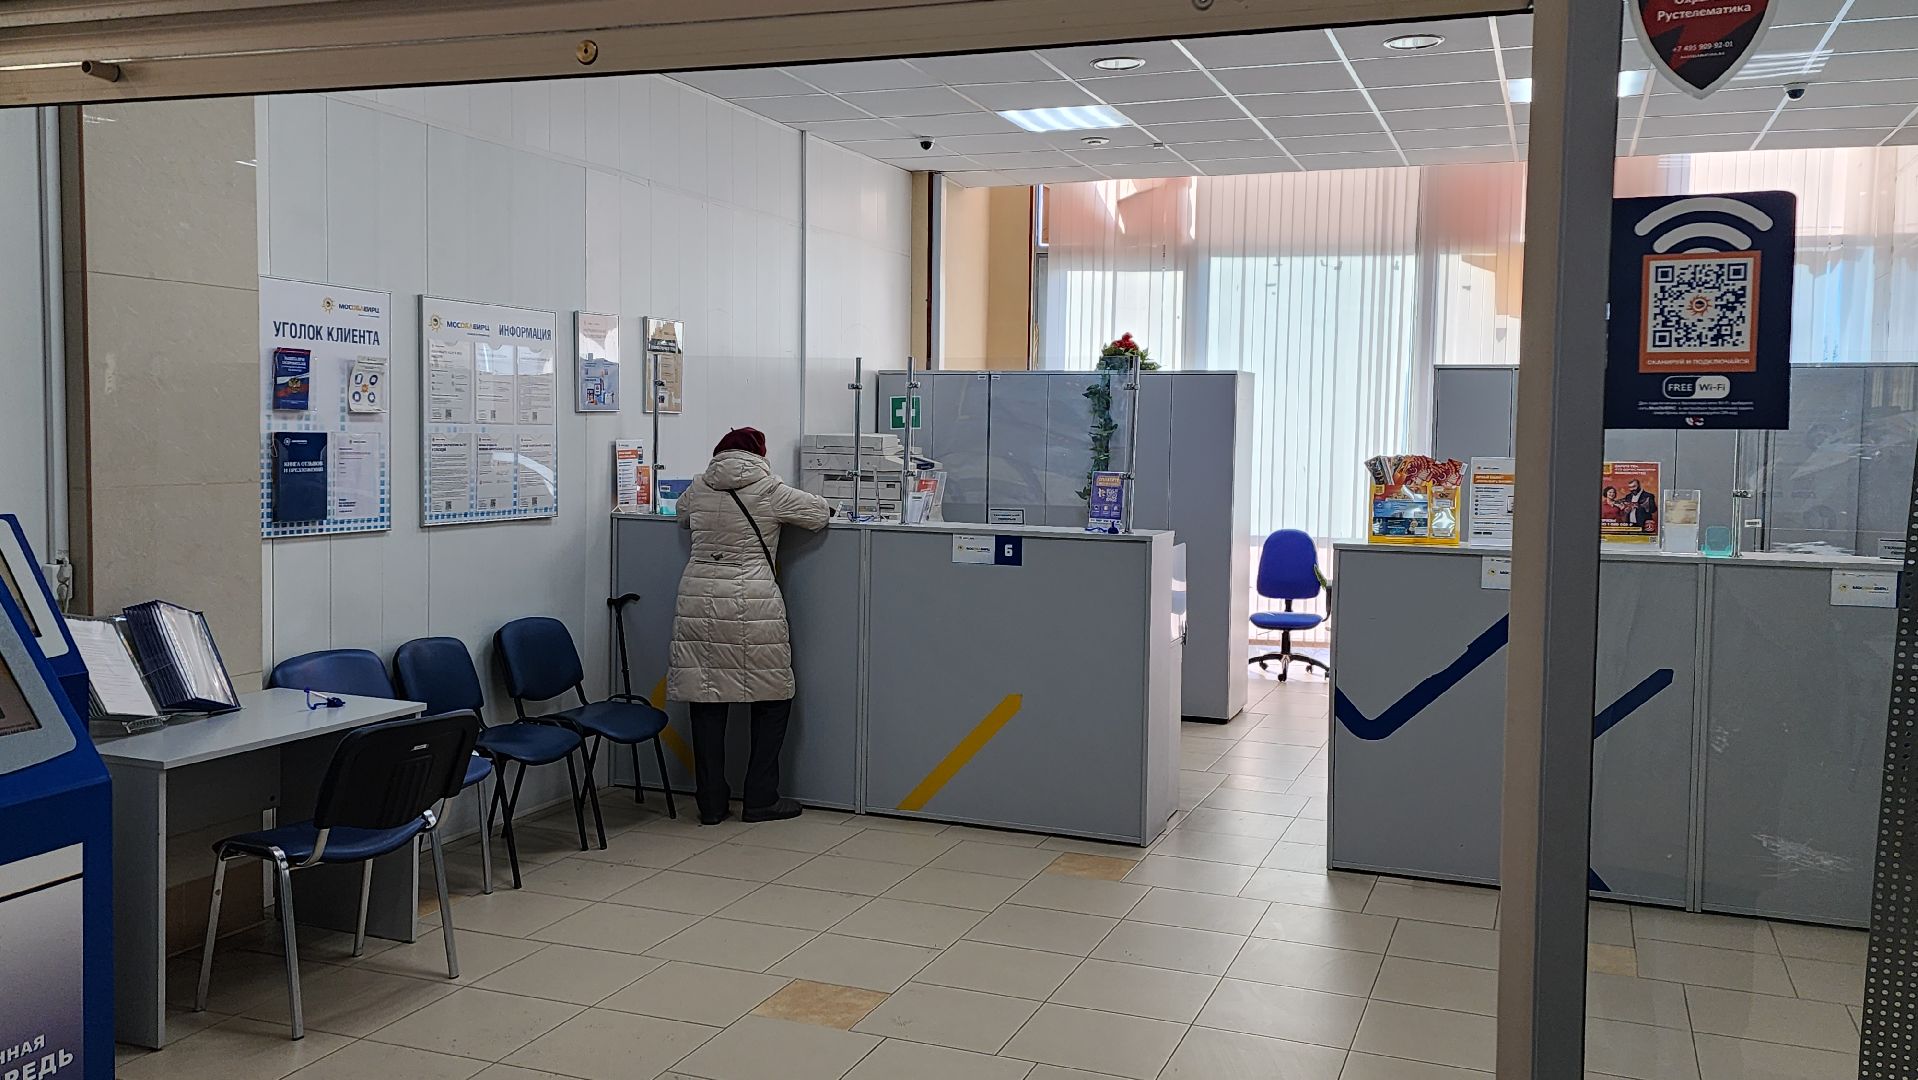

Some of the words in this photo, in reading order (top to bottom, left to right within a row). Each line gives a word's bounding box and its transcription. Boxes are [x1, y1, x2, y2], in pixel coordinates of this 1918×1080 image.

[1657, 4, 1752, 22] Рустелематика
[273, 320, 323, 341] УГОЛОК
[327, 326, 380, 346] КЛИЕНТА
[499, 324, 552, 341] ИНФОРМАЦИЯ
[1667, 383, 1693, 392] FREE
[1699, 383, 1726, 392] Wi-Fi
[1004, 544, 1013, 557] 6
